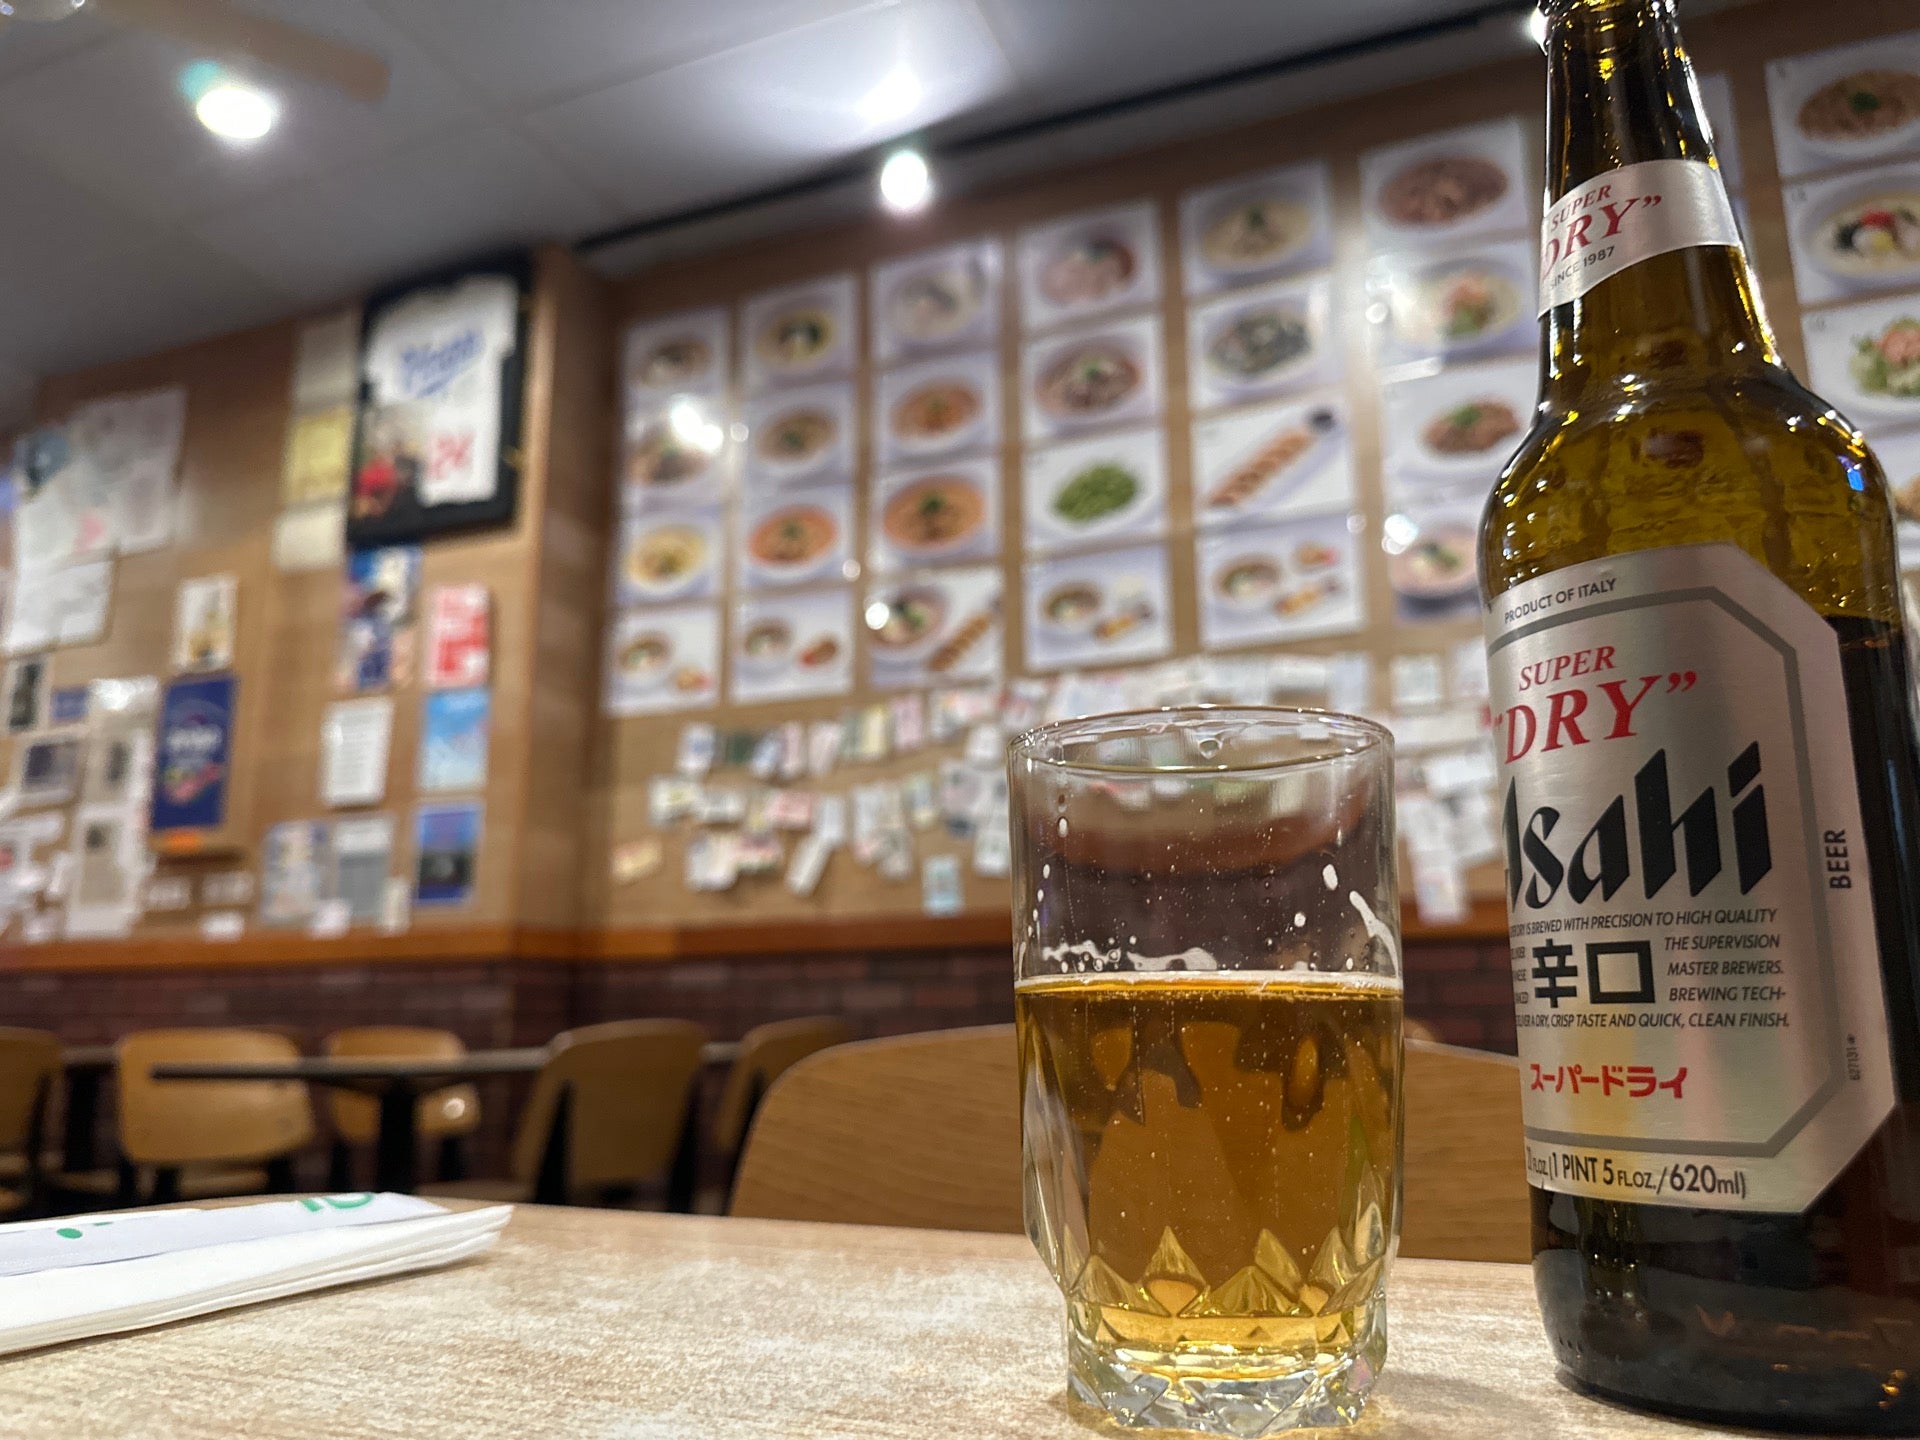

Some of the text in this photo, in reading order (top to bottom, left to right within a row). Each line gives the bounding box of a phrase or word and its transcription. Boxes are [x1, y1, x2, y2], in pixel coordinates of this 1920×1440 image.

[1551, 184, 1611, 232] SUPER
[1583, 245, 1615, 267] 1987
[1504, 594, 1552, 624] PRODUCT
[1556, 588, 1574, 604] OF
[1578, 578, 1617, 598] ITALY
[1519, 646, 1615, 692] SUPER
[1823, 829, 1852, 889] BEER
[1532, 919, 1561, 936] BREWED
[1564, 917, 1589, 932] WITH
[1591, 913, 1653, 930] PRECISION
[1656, 912, 1675, 926] TO
[1676, 910, 1713, 925] HIGH
[1715, 908, 1778, 924] QUALITY
[1664, 934, 1781, 950] THE SUPERVISION
[1532, 938, 1656, 1008] 辛口
[1667, 960, 1784, 976] MASTER BREWERS.
[1669, 986, 1786, 1001] BREWING TECH-
[1551, 1014, 1574, 1027] CRISP
[1576, 1013, 1608, 1027] TASTE
[1609, 1013, 1636, 1027] AND
[1639, 1013, 1685, 1029] QUICK,
[1688, 1013, 1737, 1027] CLEAN
[1740, 1013, 1790, 1027] FINISH.
[1530, 1064, 1688, 1099] スーパードライ
[1563, 1153, 1598, 1182] PINT
[1603, 1159, 1615, 1185] 5
